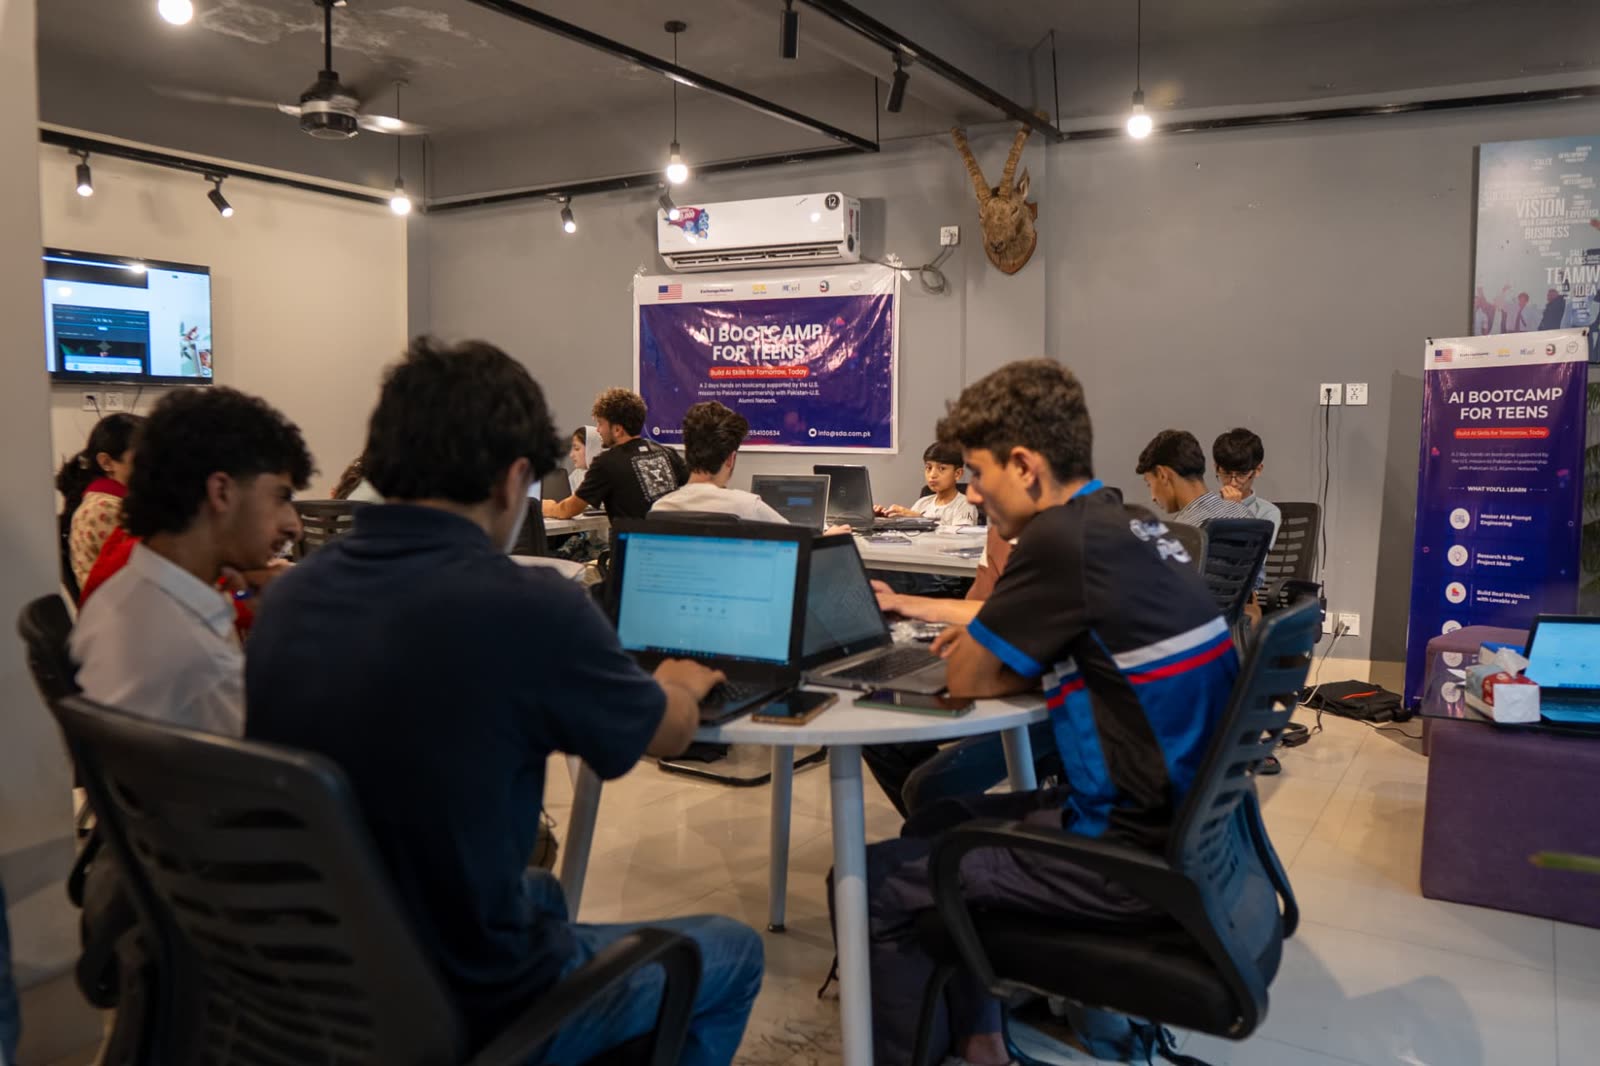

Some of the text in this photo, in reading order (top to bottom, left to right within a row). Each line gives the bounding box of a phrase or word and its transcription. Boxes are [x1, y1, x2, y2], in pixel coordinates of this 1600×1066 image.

[827, 196, 836, 207] 12
[1516, 197, 1565, 218] VISION
[1525, 226, 1570, 240] BUSINESS
[719, 324, 824, 343] BOOTCAMP
[712, 343, 806, 361] FOR TEENS
[788, 368, 807, 377] Today
[1448, 387, 1563, 404] AI BOOTCAMP
[1460, 405, 1549, 420] FOR TEENS
